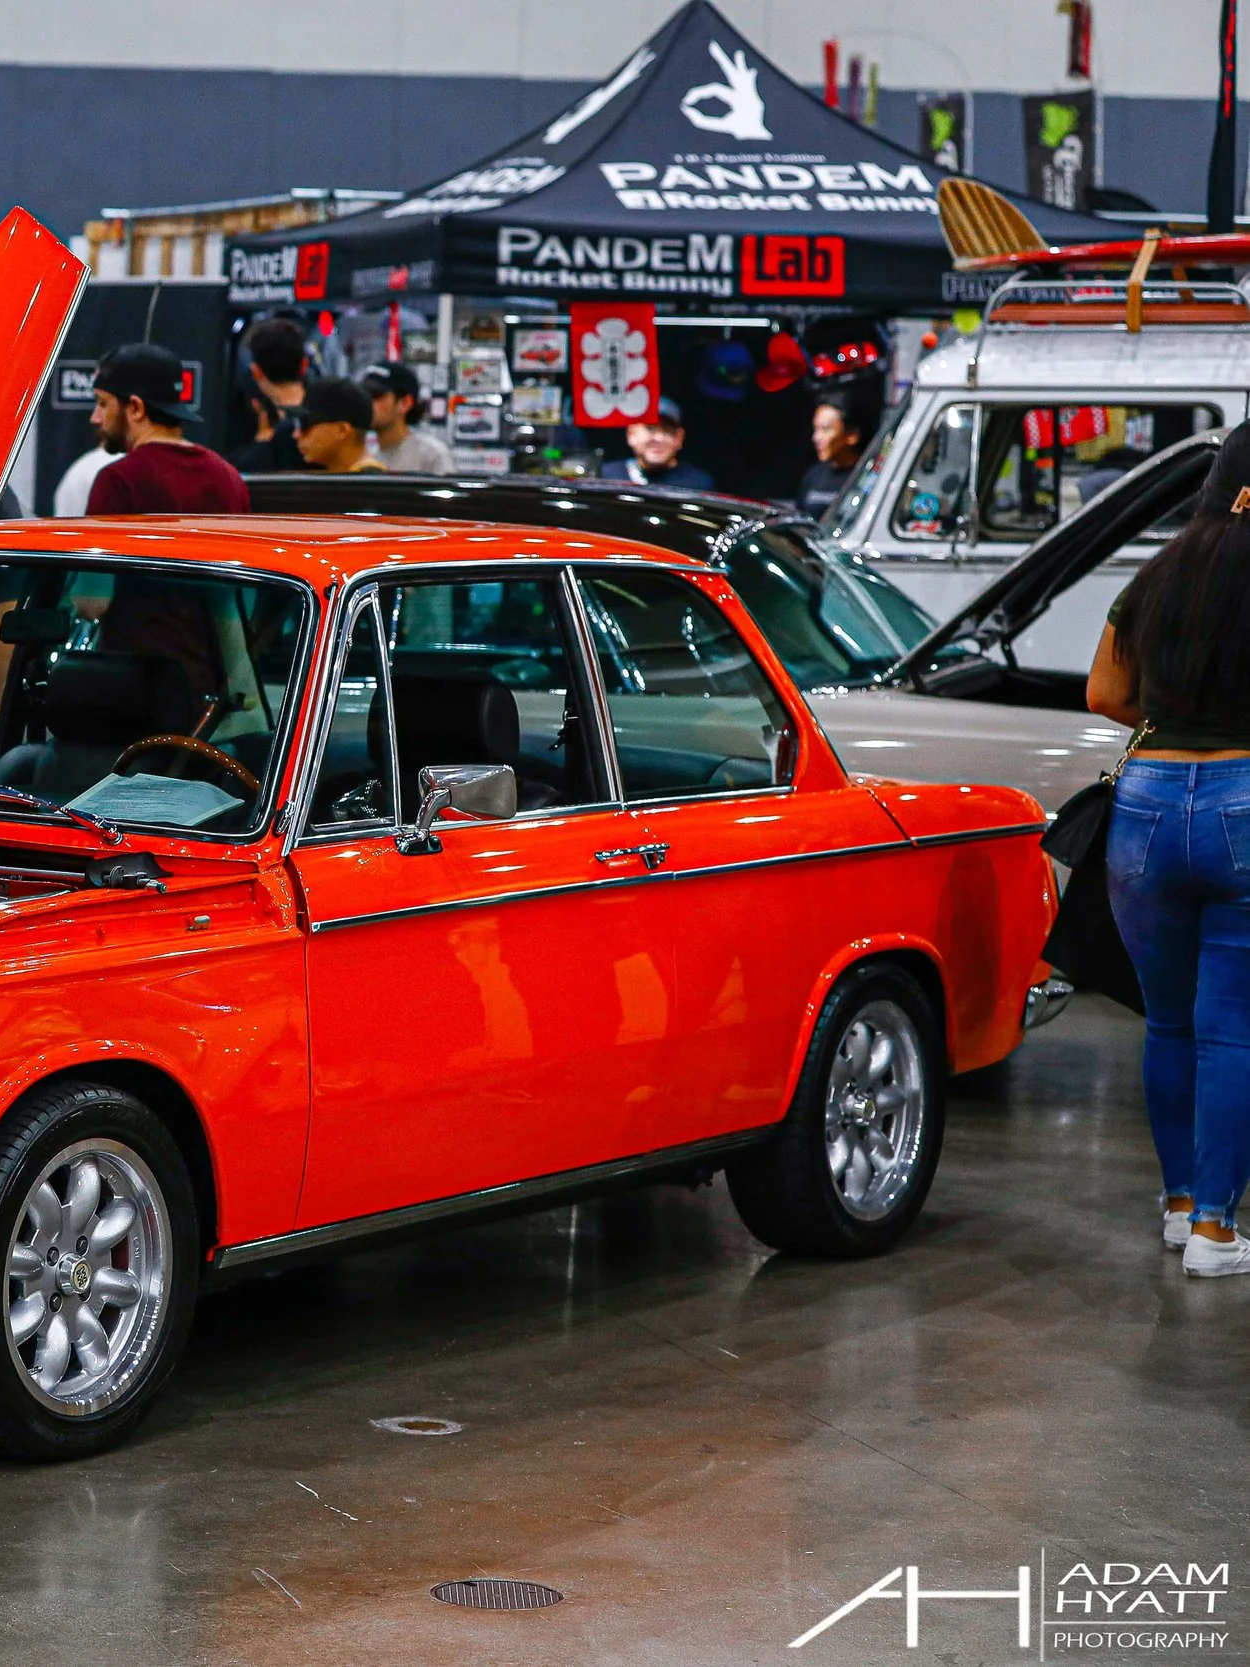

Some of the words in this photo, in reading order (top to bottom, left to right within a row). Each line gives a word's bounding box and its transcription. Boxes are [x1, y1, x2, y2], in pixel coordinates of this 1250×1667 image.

[599, 162, 934, 192] PANDEM
[663, 191, 812, 211] Rocket
[817, 193, 940, 214] Bunny
[497, 227, 734, 272] PANDEM
[755, 236, 832, 282] Lab
[497, 267, 618, 290] Rocket
[622, 271, 734, 297] Bunny
